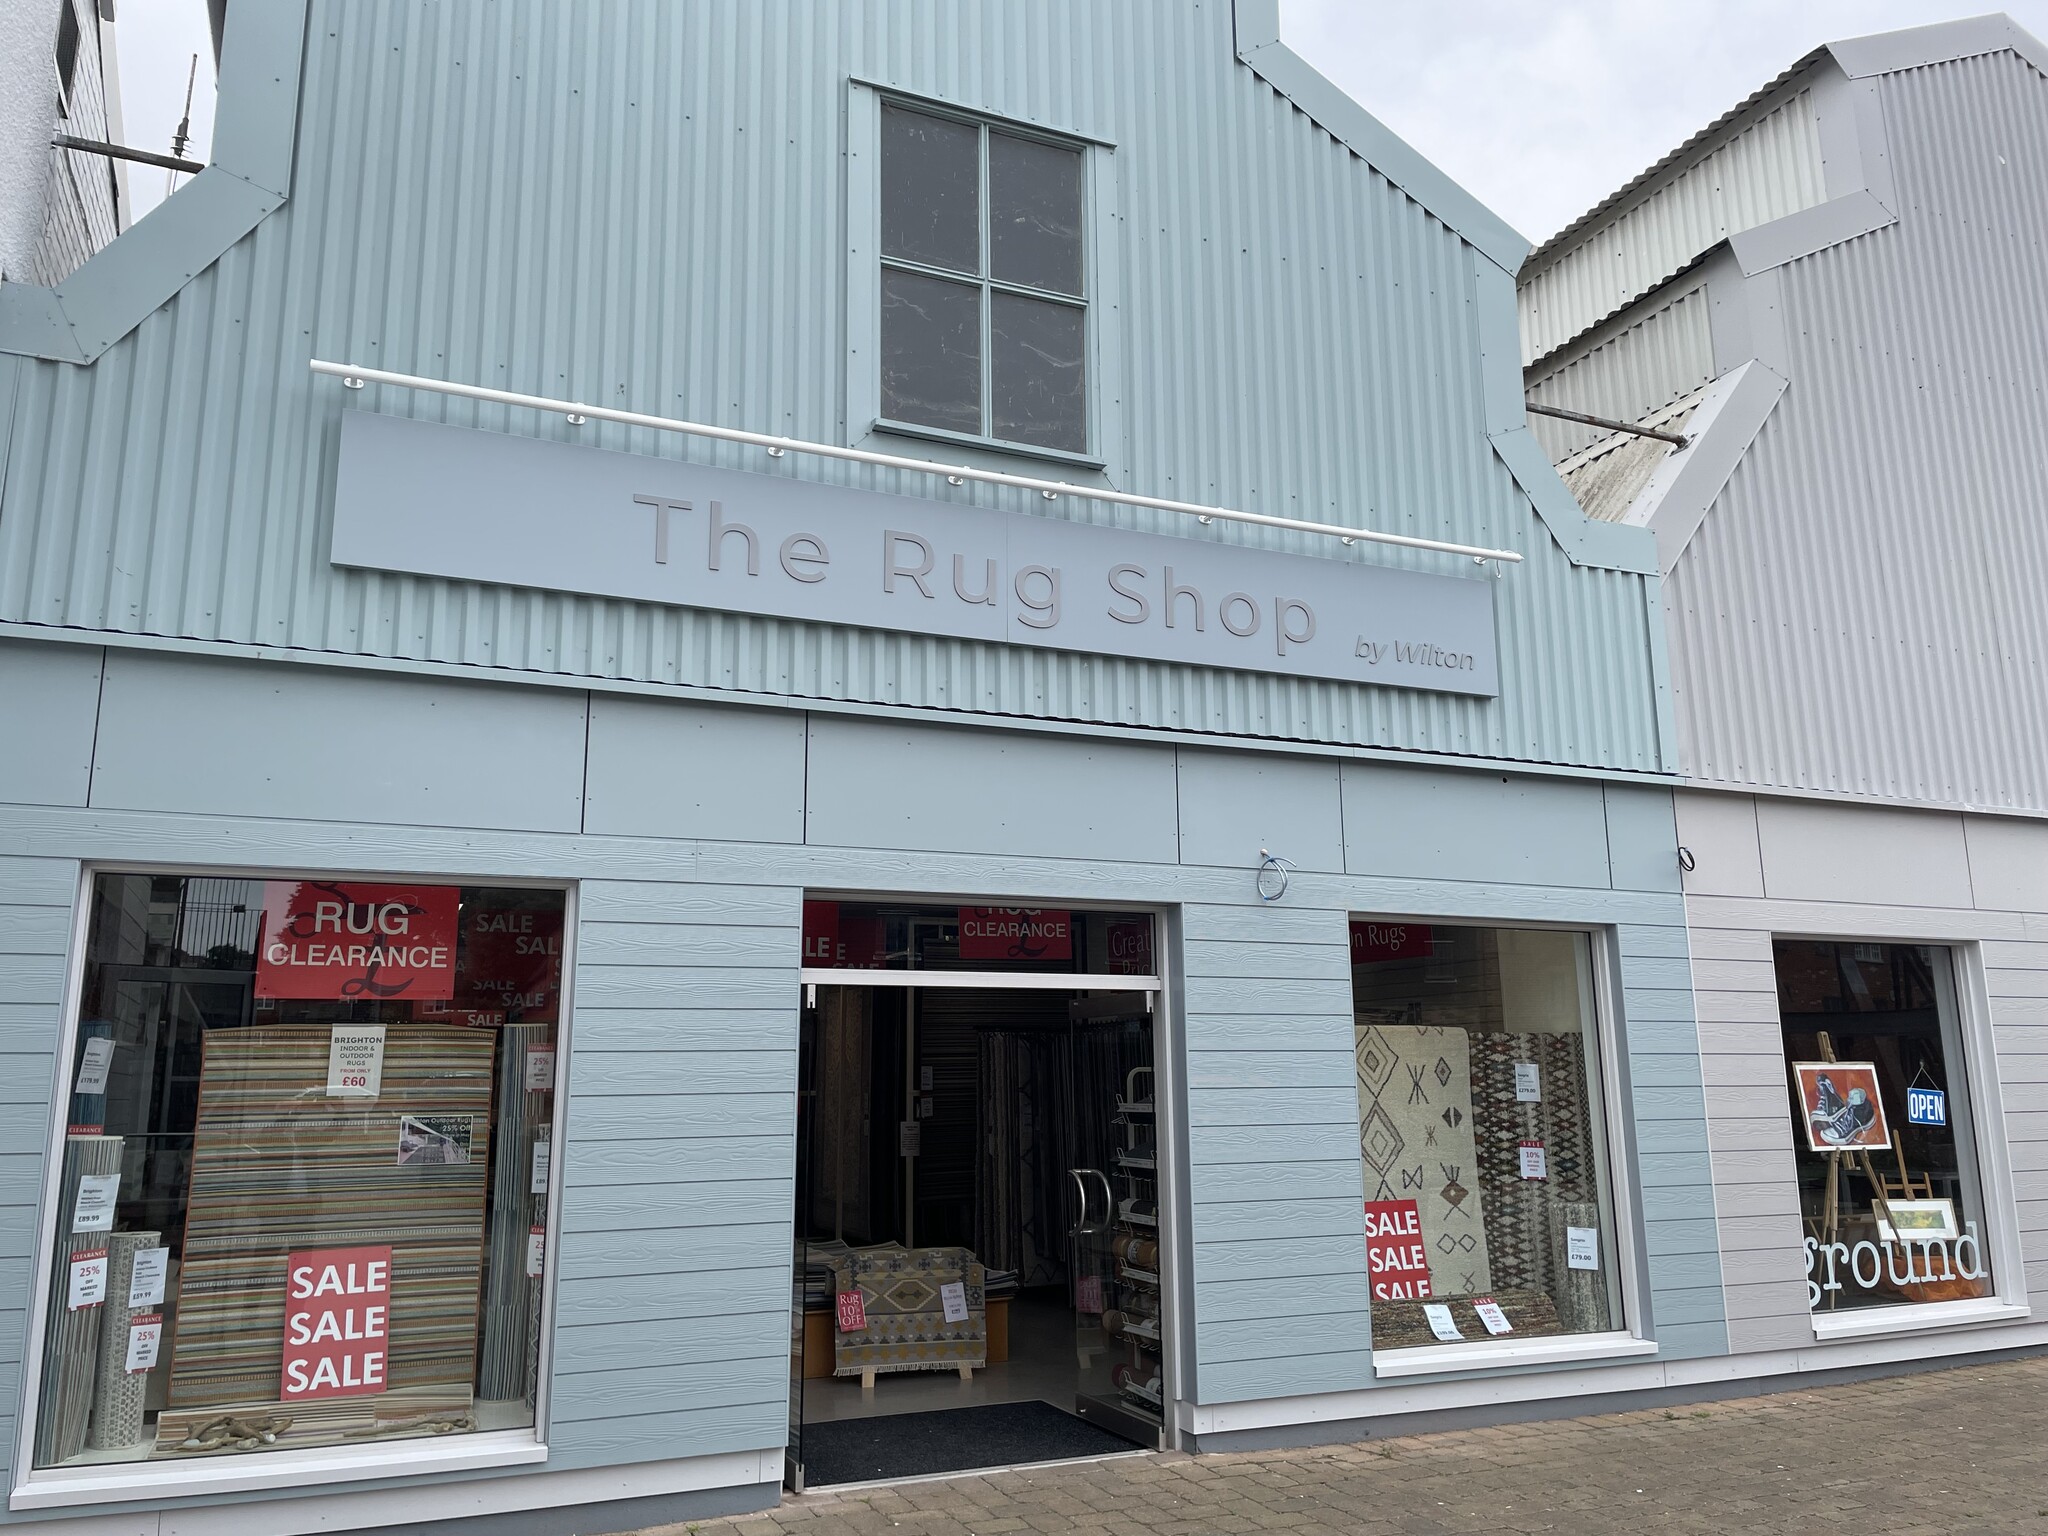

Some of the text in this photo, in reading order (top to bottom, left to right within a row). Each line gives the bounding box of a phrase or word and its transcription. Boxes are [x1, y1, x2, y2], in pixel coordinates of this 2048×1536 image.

[633, 493, 1317, 657] The Rug Shop
[1354, 635, 1474, 671] by Wilton
[314, 900, 409, 936] RUG
[475, 914, 533, 934] SALE
[964, 921, 1067, 938] CLEARANCE
[1368, 924, 1407, 951] Rugs
[515, 936, 561, 955] SAL
[803, 936, 830, 958] LE
[1112, 929, 1150, 957] Great
[267, 943, 448, 969] CLEARANCE
[502, 992, 544, 1007] SALE
[467, 1014, 503, 1027] SALE
[334, 1036, 383, 1044] BRIGHTON
[533, 1057, 549, 1066] 25%
[342, 1076, 366, 1087] £60
[1910, 1093, 1944, 1121] OPEN
[1525, 1151, 1540, 1159] 10%
[78, 1214, 100, 1223] £89.99
[1365, 1211, 1420, 1238] SALE
[72, 1250, 107, 1260] CLEARANCE
[1369, 1244, 1426, 1273] SALE
[1571, 1253, 1592, 1261] £79.00
[80, 1265, 100, 1277] 25%
[291, 1260, 387, 1299] SALE
[132, 1291, 152, 1300] £59.99
[839, 1294, 859, 1306] Rug
[1482, 1307, 1497, 1315] 10%
[132, 1316, 162, 1325] CLEARANCE
[288, 1305, 386, 1346] SALE
[842, 1315, 862, 1326] OFF
[137, 1330, 155, 1341] 25%
[286, 1352, 384, 1393] SALE
